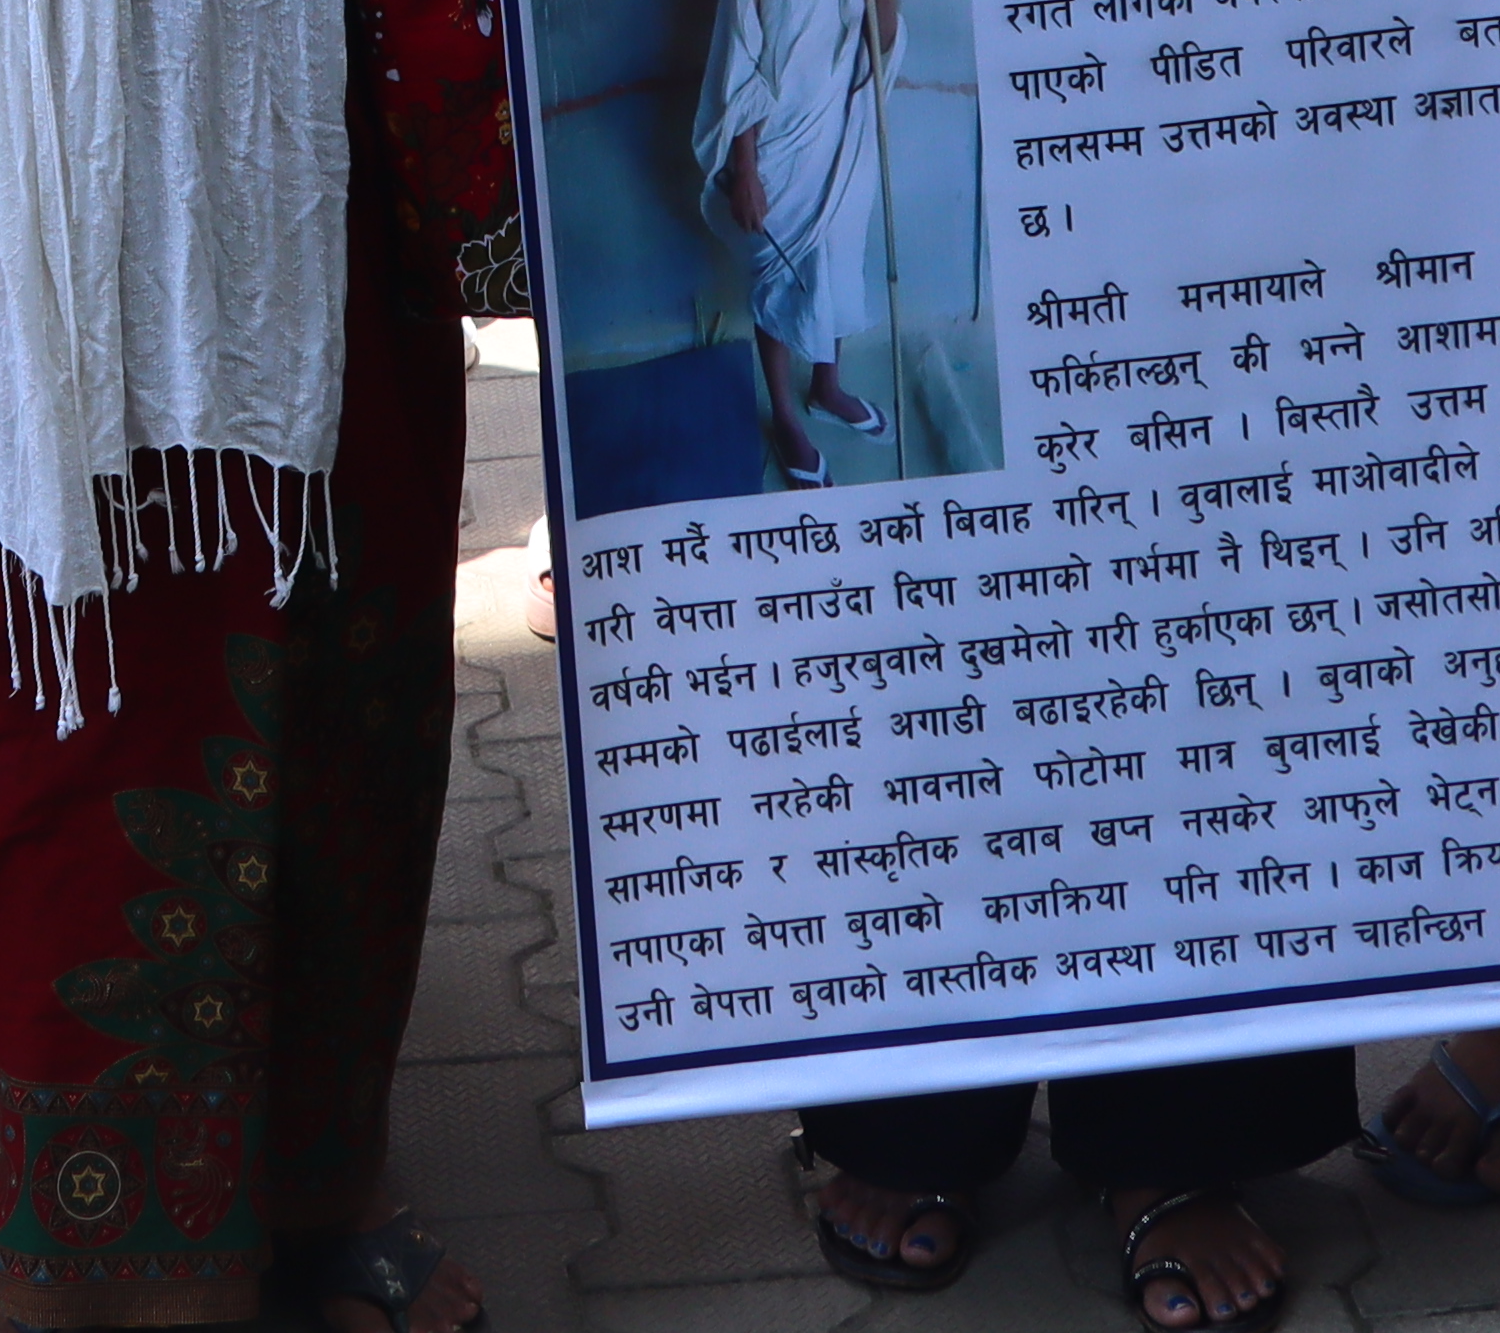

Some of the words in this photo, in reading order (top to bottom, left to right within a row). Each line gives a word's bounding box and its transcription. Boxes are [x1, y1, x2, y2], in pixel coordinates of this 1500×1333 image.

[1028, 283, 1128, 328] श्रीमती
[1178, 260, 1325, 311] मनमायाले
[1378, 249, 1474, 287] श्रीमान
[601, 799, 720, 839] स्मरणमा
[752, 774, 852, 819] नरहेकी
[885, 759, 1003, 804] भावनाले
[1034, 747, 1145, 788] फोटोमा
[1177, 742, 1235, 772] मात्र
[1264, 714, 1380, 773] बुवालाई
[1409, 704, 1499, 747] देखेकी
[617, 989, 674, 1030] उनी
[692, 984, 773, 1019] बेपत्ता
[790, 964, 886, 1018] बुवाको
[904, 952, 1037, 995] वास्तविक
[1057, 944, 1155, 978] अवस्था
[1175, 935, 1239, 962] थाहा
[1255, 926, 1336, 950] पाउन
[1353, 906, 1485, 937] चाहन्छिन
